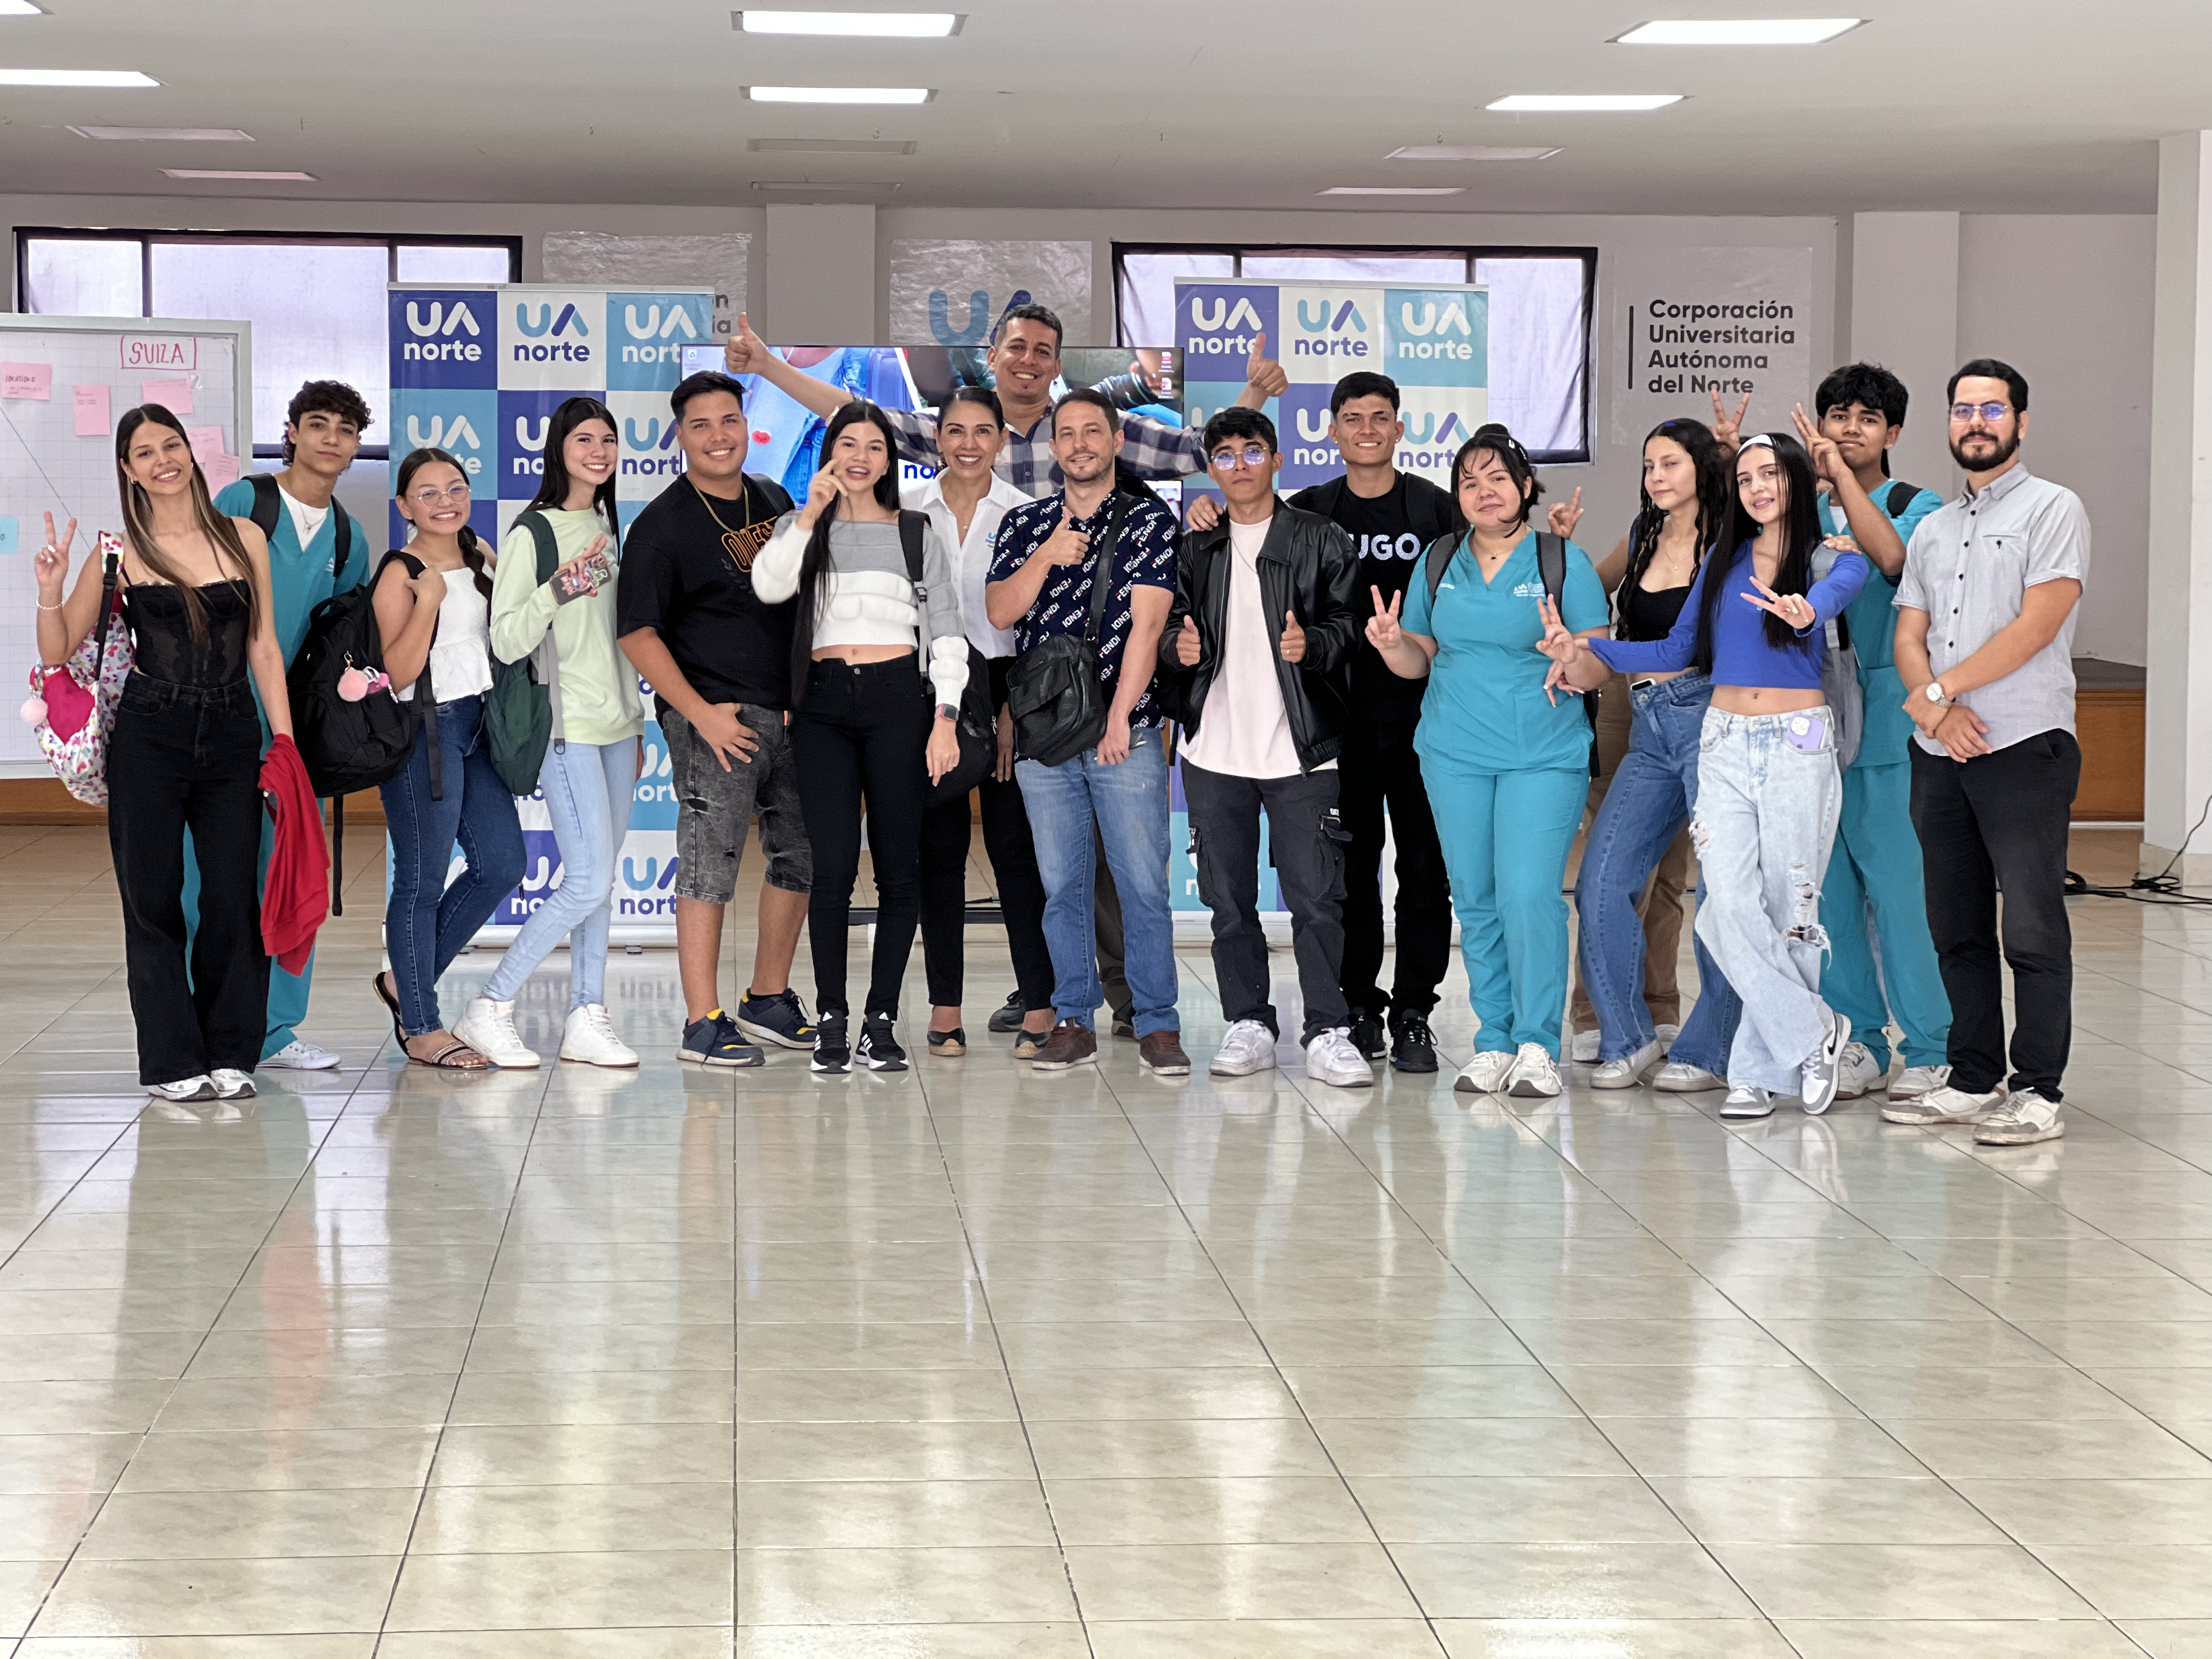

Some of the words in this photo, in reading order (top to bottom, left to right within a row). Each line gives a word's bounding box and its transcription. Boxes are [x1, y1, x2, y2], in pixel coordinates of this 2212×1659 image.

[407, 301, 481, 336] UA
[516, 303, 589, 337] UA
[625, 304, 697, 338] UA
[1192, 297, 1262, 331] UA
[1297, 300, 1368, 332] UA
[1402, 302, 1471, 336] UA
[1649, 300, 1793, 323] Corporación
[1649, 324, 1795, 344] Universitaria
[129, 342, 185, 364] SUIZA
[404, 340, 482, 361] norte
[514, 341, 590, 362] norte
[622, 343, 680, 363] nort
[1294, 337, 1368, 357] norte
[1398, 338, 1474, 360] norte
[1648, 349, 1769, 369] Autónoma
[1648, 375, 1684, 393] del
[1691, 375, 1754, 394] Norte
[407, 415, 481, 449] UA
[622, 456, 680, 476] nort
[1398, 450, 1455, 469] nort
[1136, 520, 1157, 548] FENDI
[1150, 546, 1174, 569] FENDI
[1049, 578, 1074, 599] FENDI
[1071, 578, 1092, 601] FENDI
[1039, 602, 1060, 625] FENDI
[1062, 606, 1086, 628] FENDI
[1098, 634, 1121, 658] FENDI
[620, 894, 676, 915] nort
